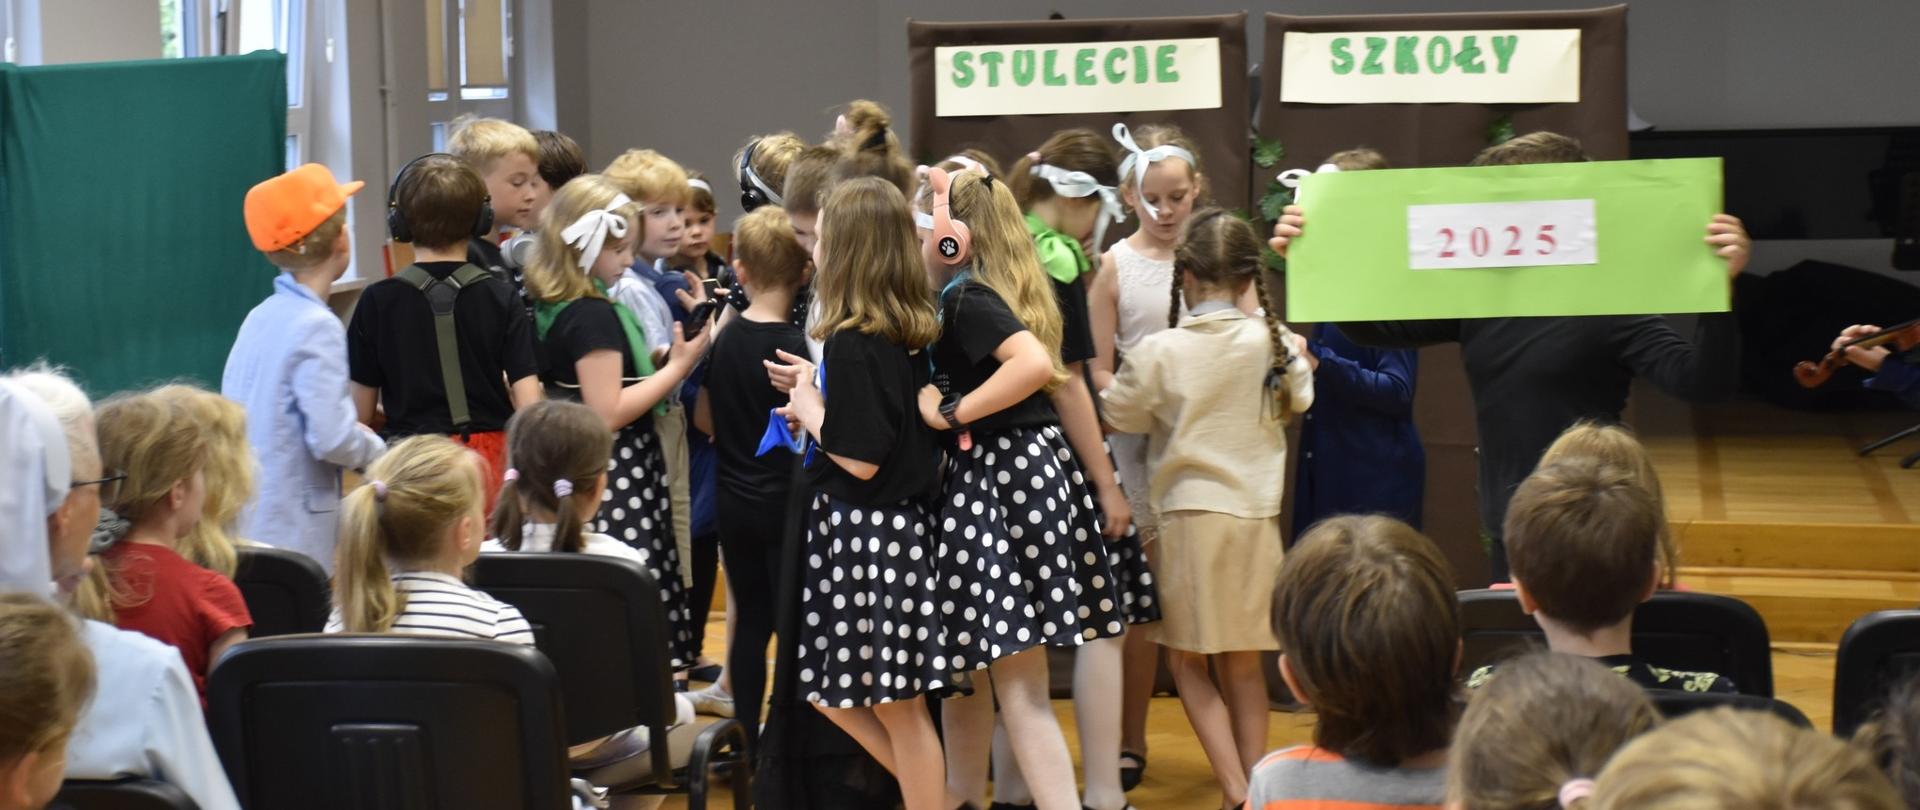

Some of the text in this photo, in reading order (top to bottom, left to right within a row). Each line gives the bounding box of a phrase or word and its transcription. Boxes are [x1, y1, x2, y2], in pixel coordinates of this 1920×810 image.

[952, 44, 1180, 88] STULECIE
[1330, 35, 1518, 75] SZKOŁY
[1437, 225, 1557, 258] 2025
